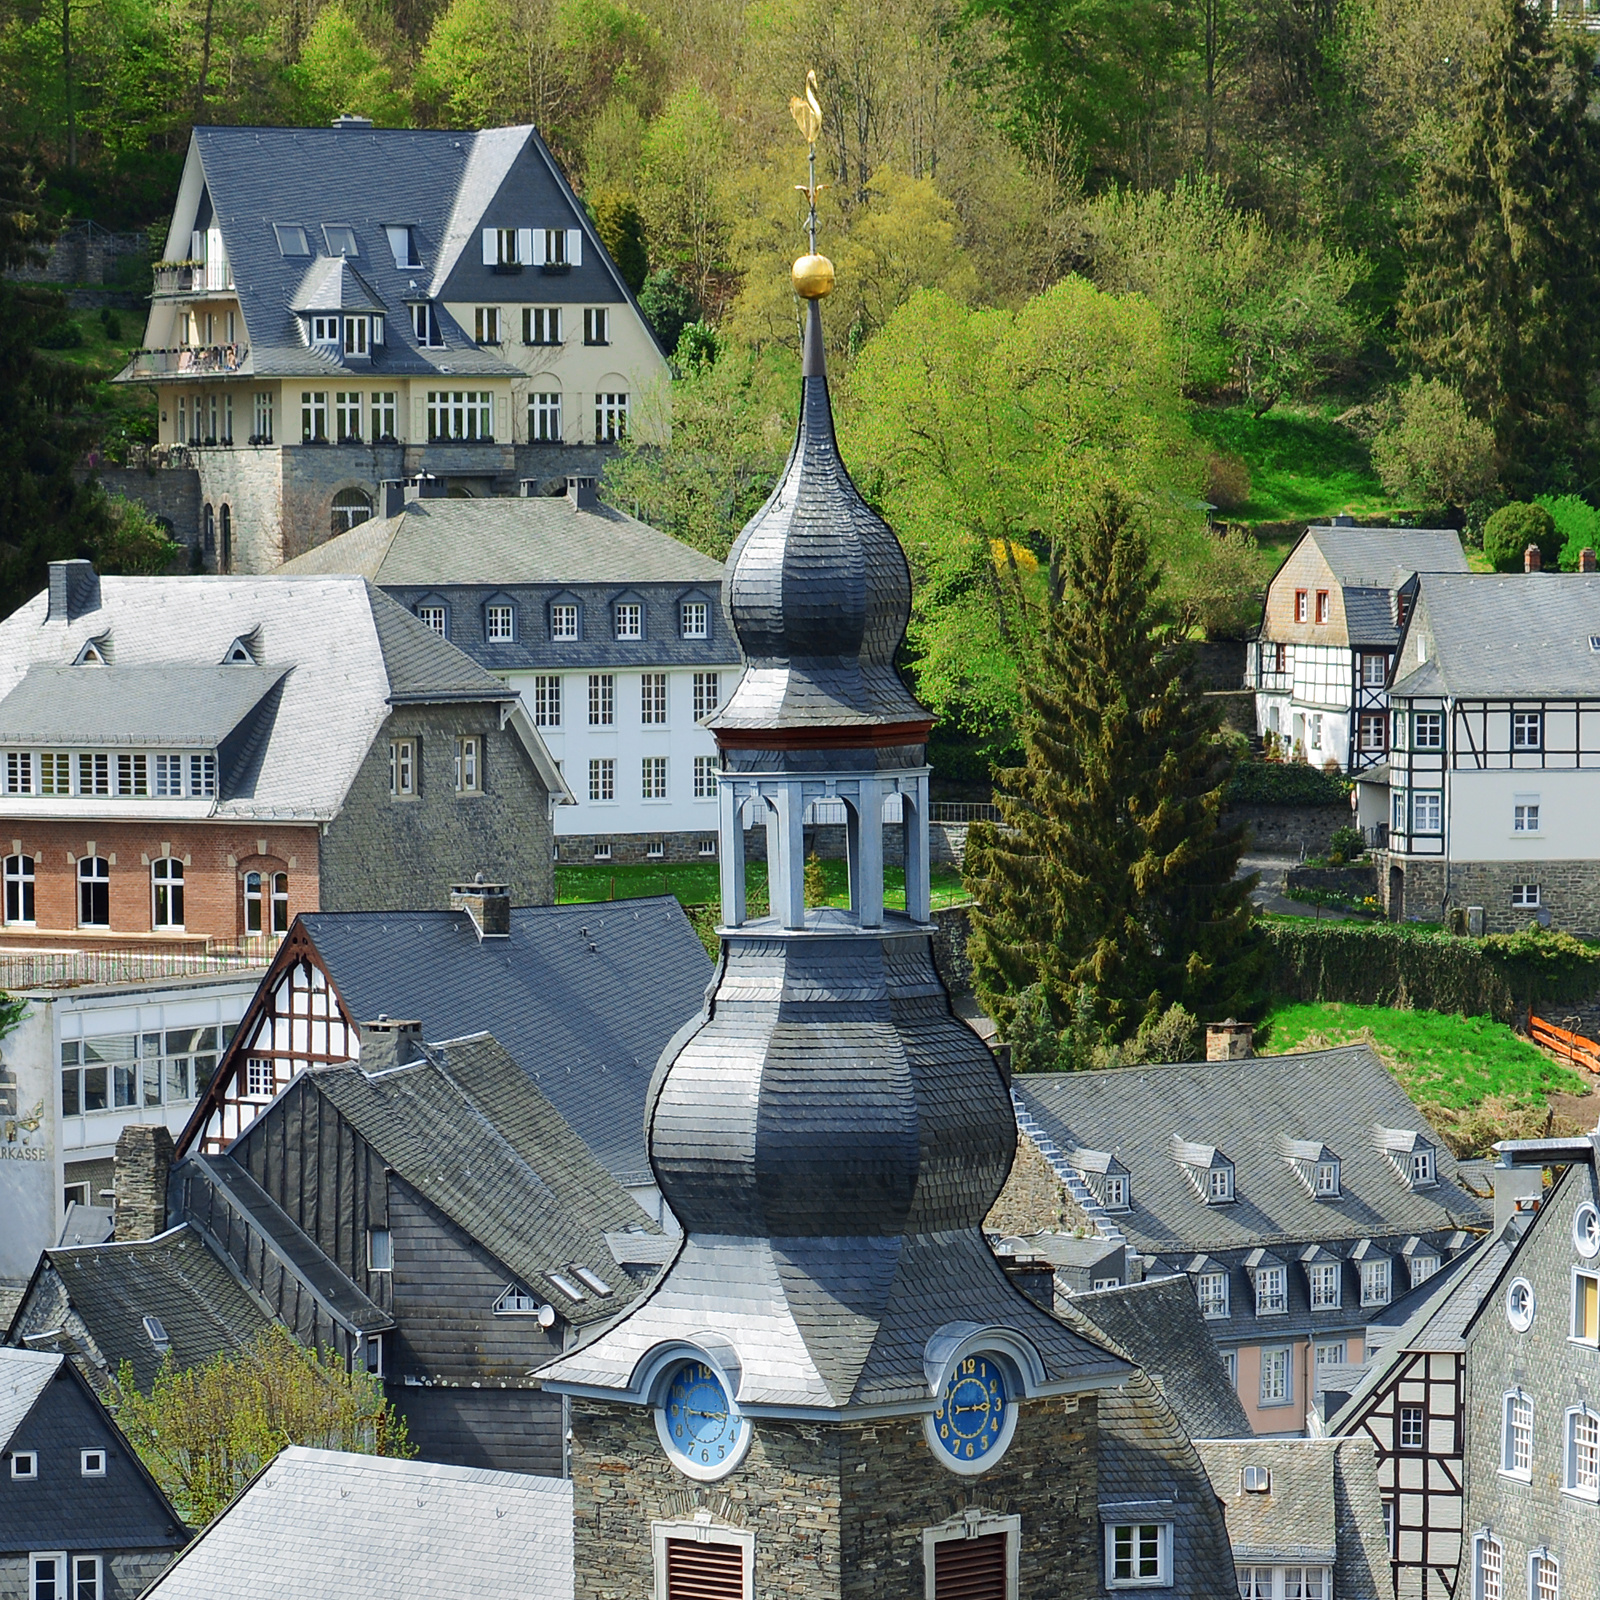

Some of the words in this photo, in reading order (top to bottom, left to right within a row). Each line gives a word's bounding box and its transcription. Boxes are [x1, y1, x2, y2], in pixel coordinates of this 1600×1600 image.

[698, 1364, 712, 1380] 12
[962, 1359, 975, 1374] 12
[980, 1363, 986, 1377] 1
[683, 1369, 694, 1383] 11
[672, 1385, 685, 1399] 10
[990, 1379, 997, 1394] 2
[671, 1404, 679, 1418] 9
[994, 1398, 1002, 1412] 3
[675, 1424, 683, 1437] 8
[940, 1424, 949, 1439] 8
[990, 1417, 998, 1432] 4
[729, 1430, 736, 1443] 4
[981, 1435, 989, 1450] 5
[688, 1442, 696, 1456] 7
[717, 1445, 725, 1459] 5
[953, 1439, 961, 1454] 7
[966, 1443, 974, 1458] 6
[701, 1448, 709, 1463] 6
